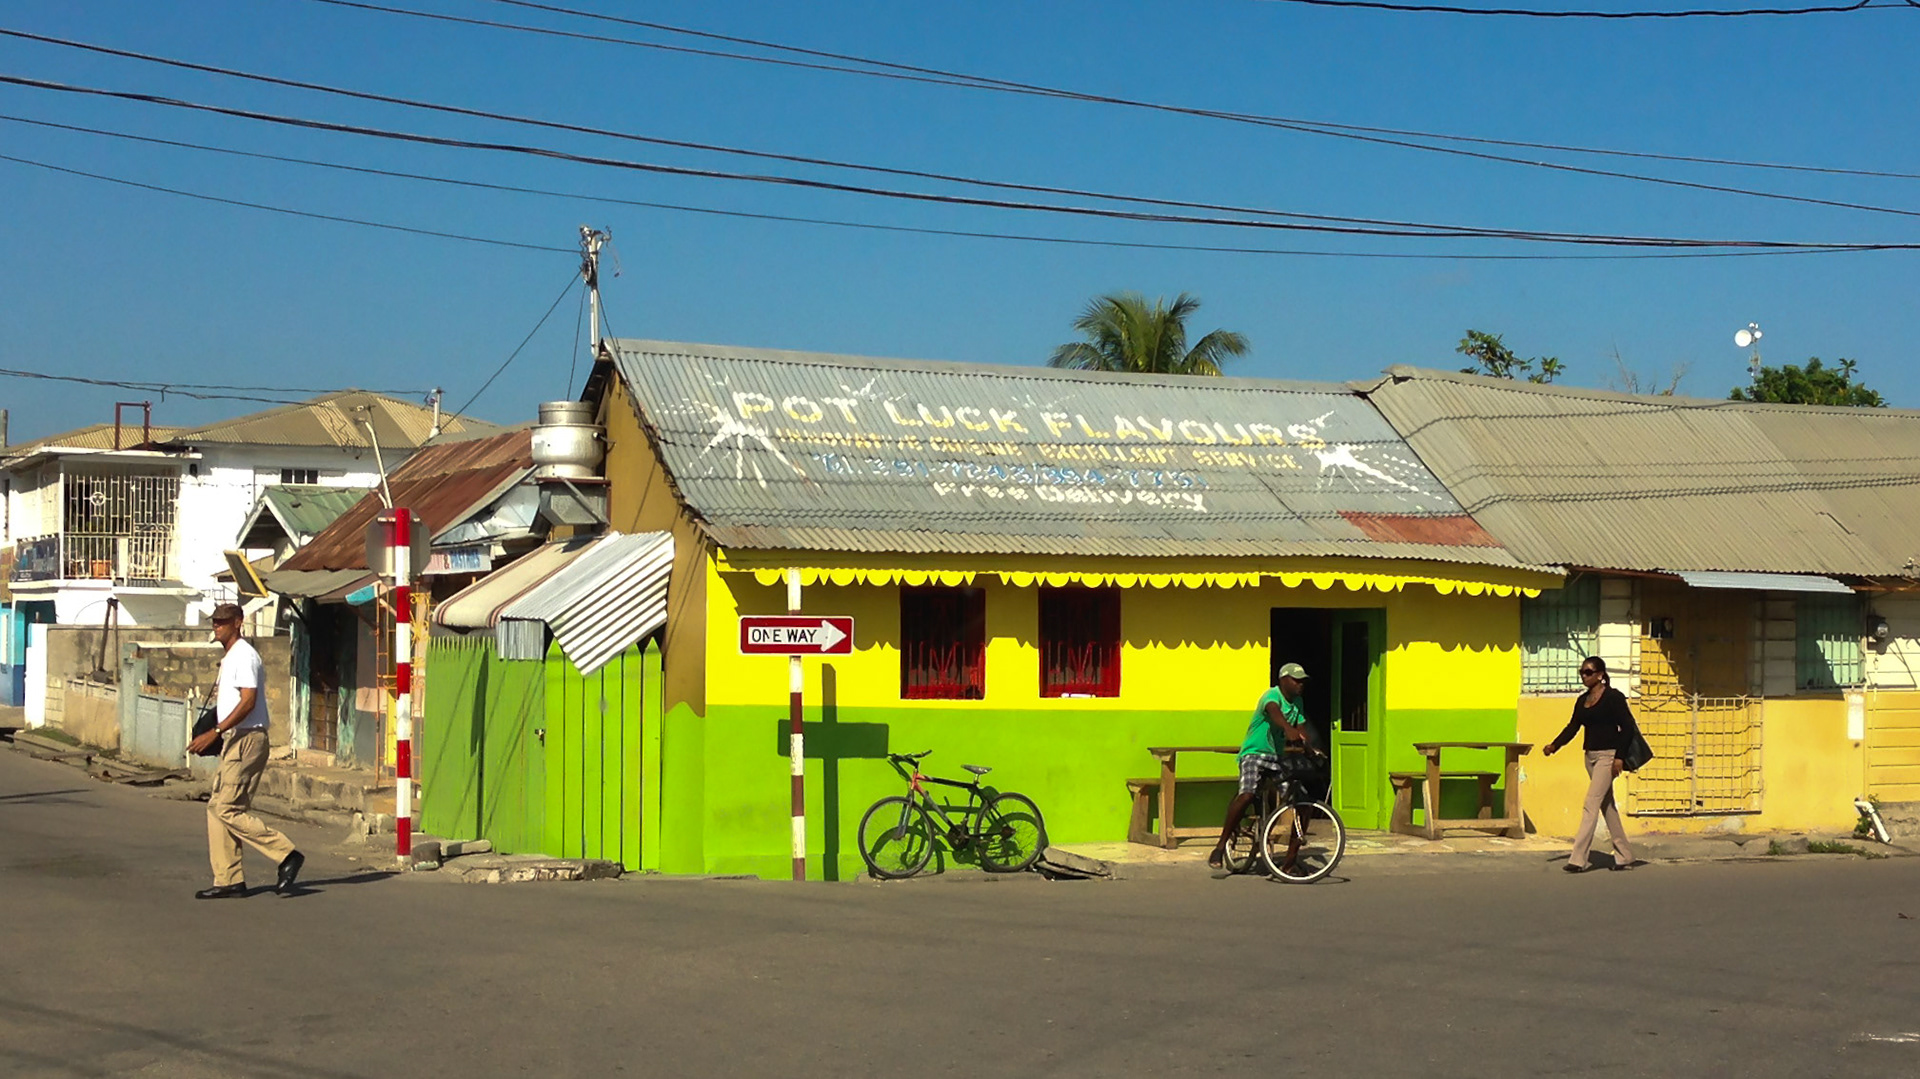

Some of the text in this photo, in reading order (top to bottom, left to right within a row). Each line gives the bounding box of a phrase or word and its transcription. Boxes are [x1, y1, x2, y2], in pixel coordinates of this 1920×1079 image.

[733, 391, 1326, 449] POT LUCK FLAVOURS
[1193, 449, 1302, 469] SERVICE
[934, 481, 1207, 513] Free Delivery
[752, 629, 817, 643] ONE WAY
